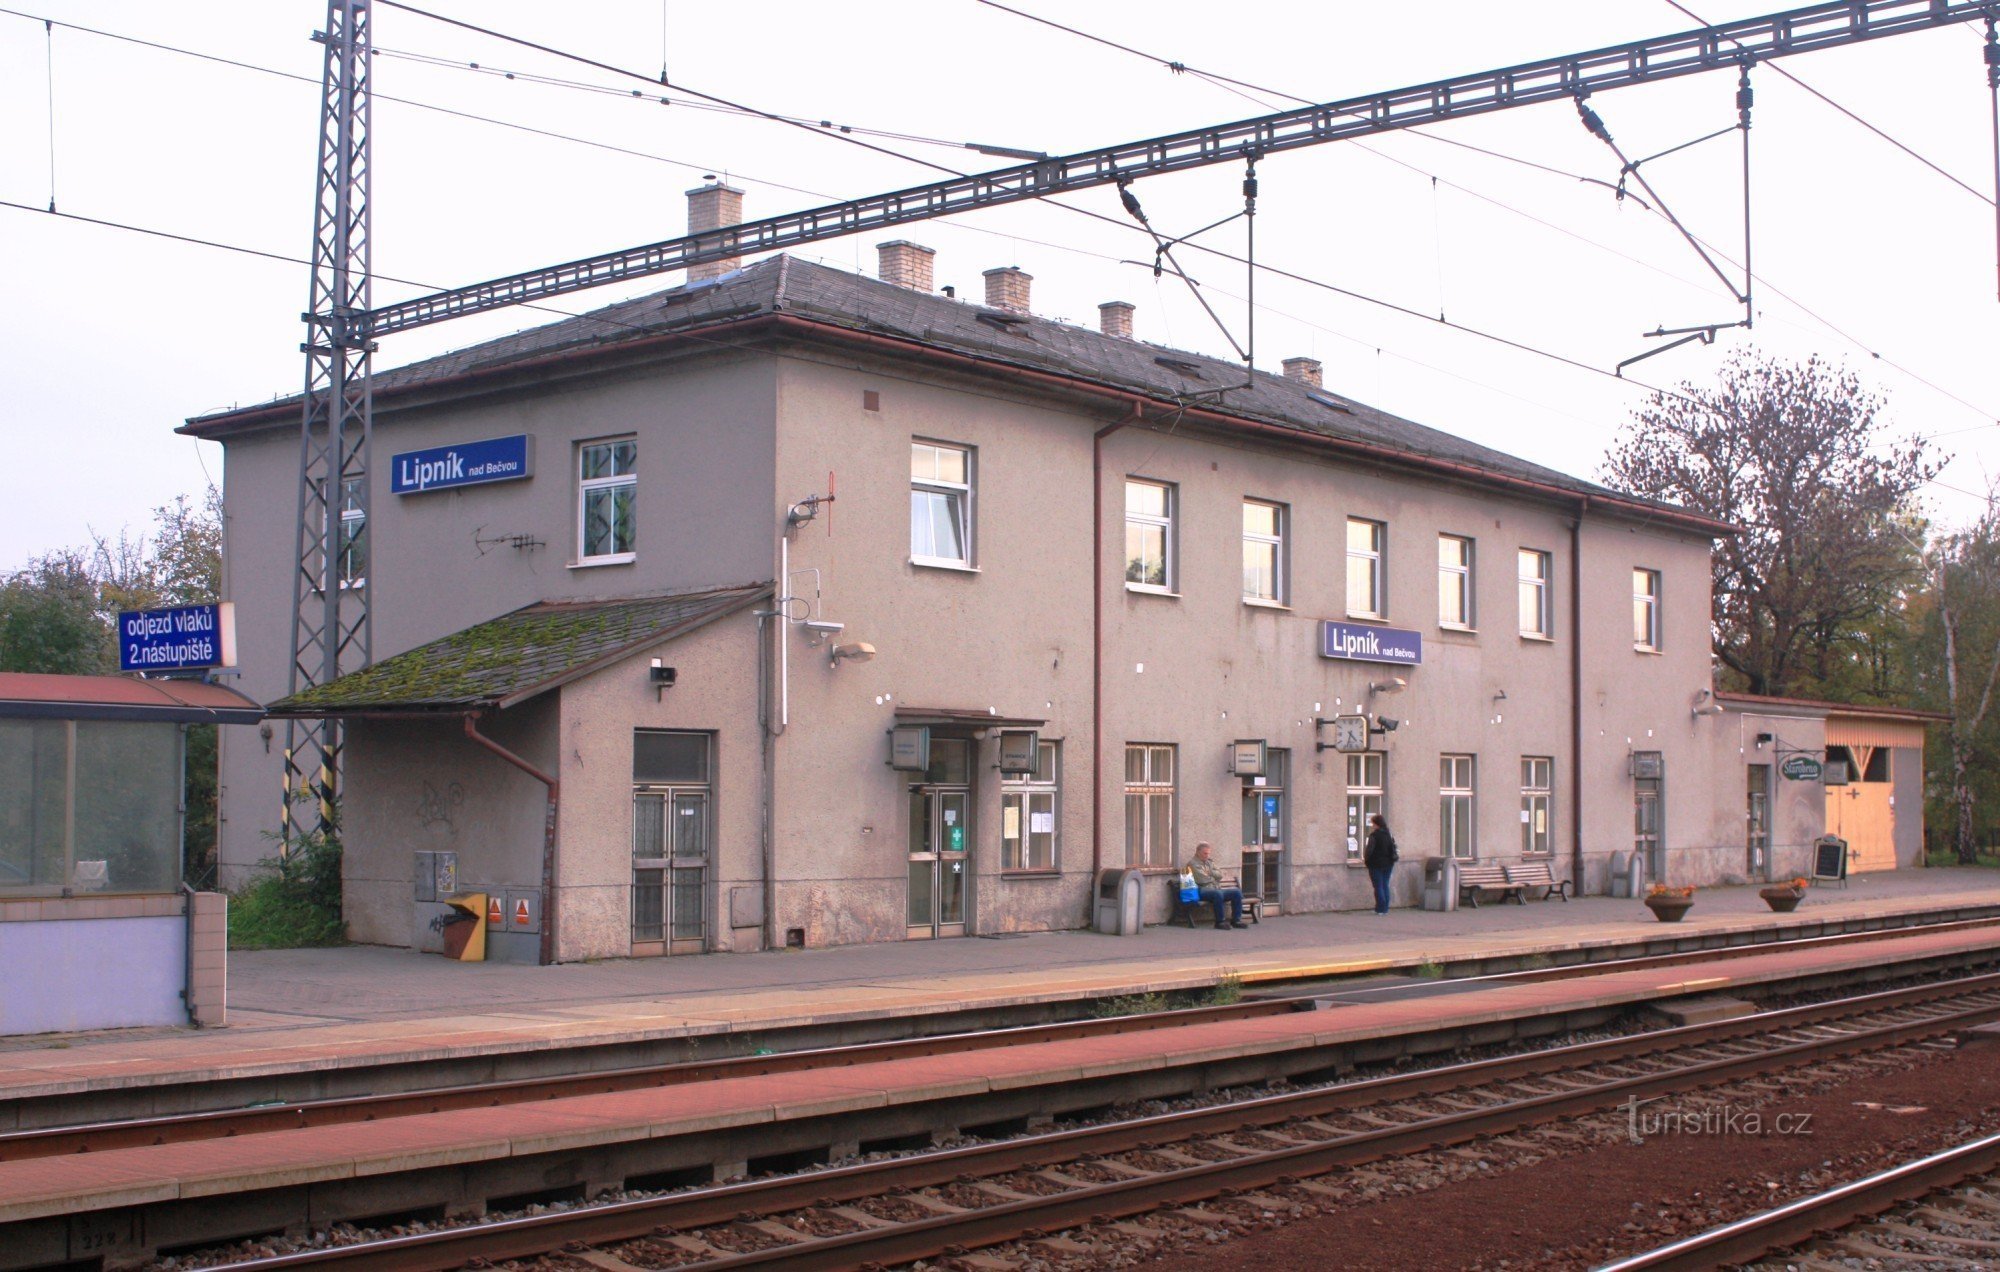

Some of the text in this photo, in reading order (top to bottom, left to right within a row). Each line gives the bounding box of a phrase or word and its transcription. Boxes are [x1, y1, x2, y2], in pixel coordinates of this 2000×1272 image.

[402, 452, 518, 490] Lipník nad Bečvou
[128, 606, 213, 640] odjezd vlaků
[130, 637, 213, 666] 2.nástupiště
[1333, 628, 1416, 659] Lipník nad Bečvou
